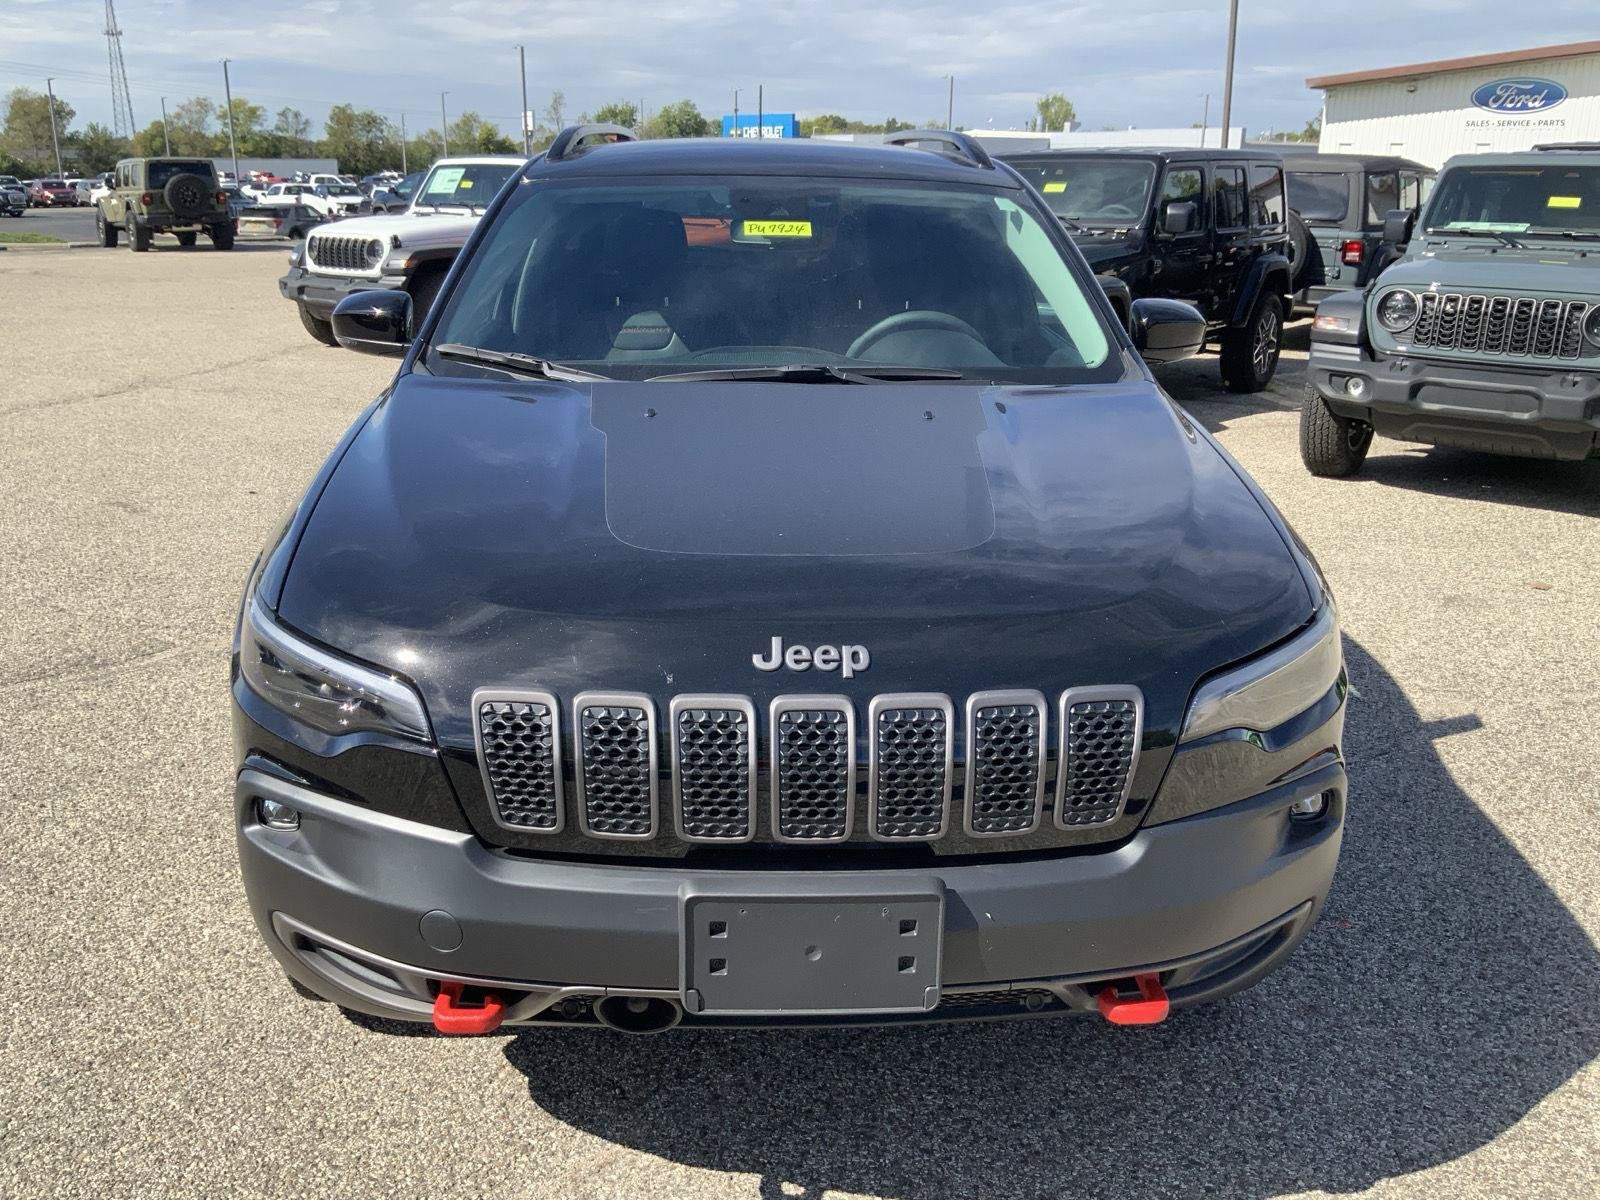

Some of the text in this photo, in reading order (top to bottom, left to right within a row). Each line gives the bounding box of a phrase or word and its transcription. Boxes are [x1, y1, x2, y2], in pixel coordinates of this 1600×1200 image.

[1488, 82, 1549, 108] Ford
[1465, 119, 1566, 128] SALES SERVICE PARTS
[752, 636, 870, 679] Jeep
